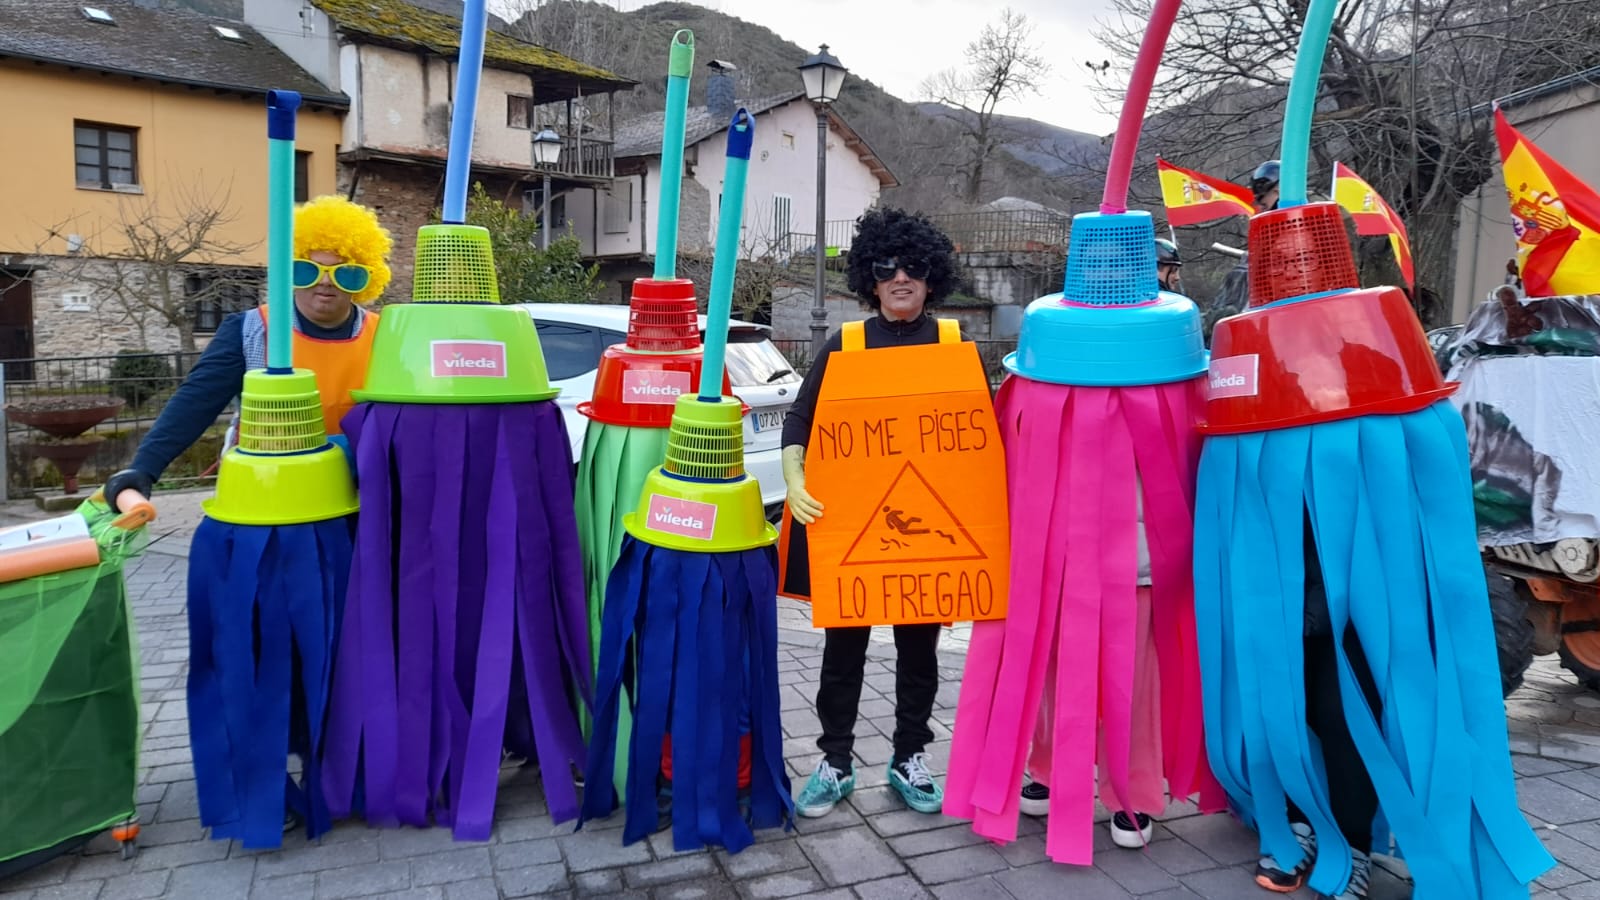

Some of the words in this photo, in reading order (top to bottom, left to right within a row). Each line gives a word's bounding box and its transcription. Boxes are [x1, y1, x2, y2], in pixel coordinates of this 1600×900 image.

[443, 352, 497, 369] vileda
[632, 379, 682, 396] vileda
[759, 411, 780, 428] 0720
[818, 421, 854, 460] NO
[864, 418, 902, 457] ME
[655, 506, 704, 530] vileda
[837, 576, 866, 619] LO
[883, 569, 993, 619] FREGAO
